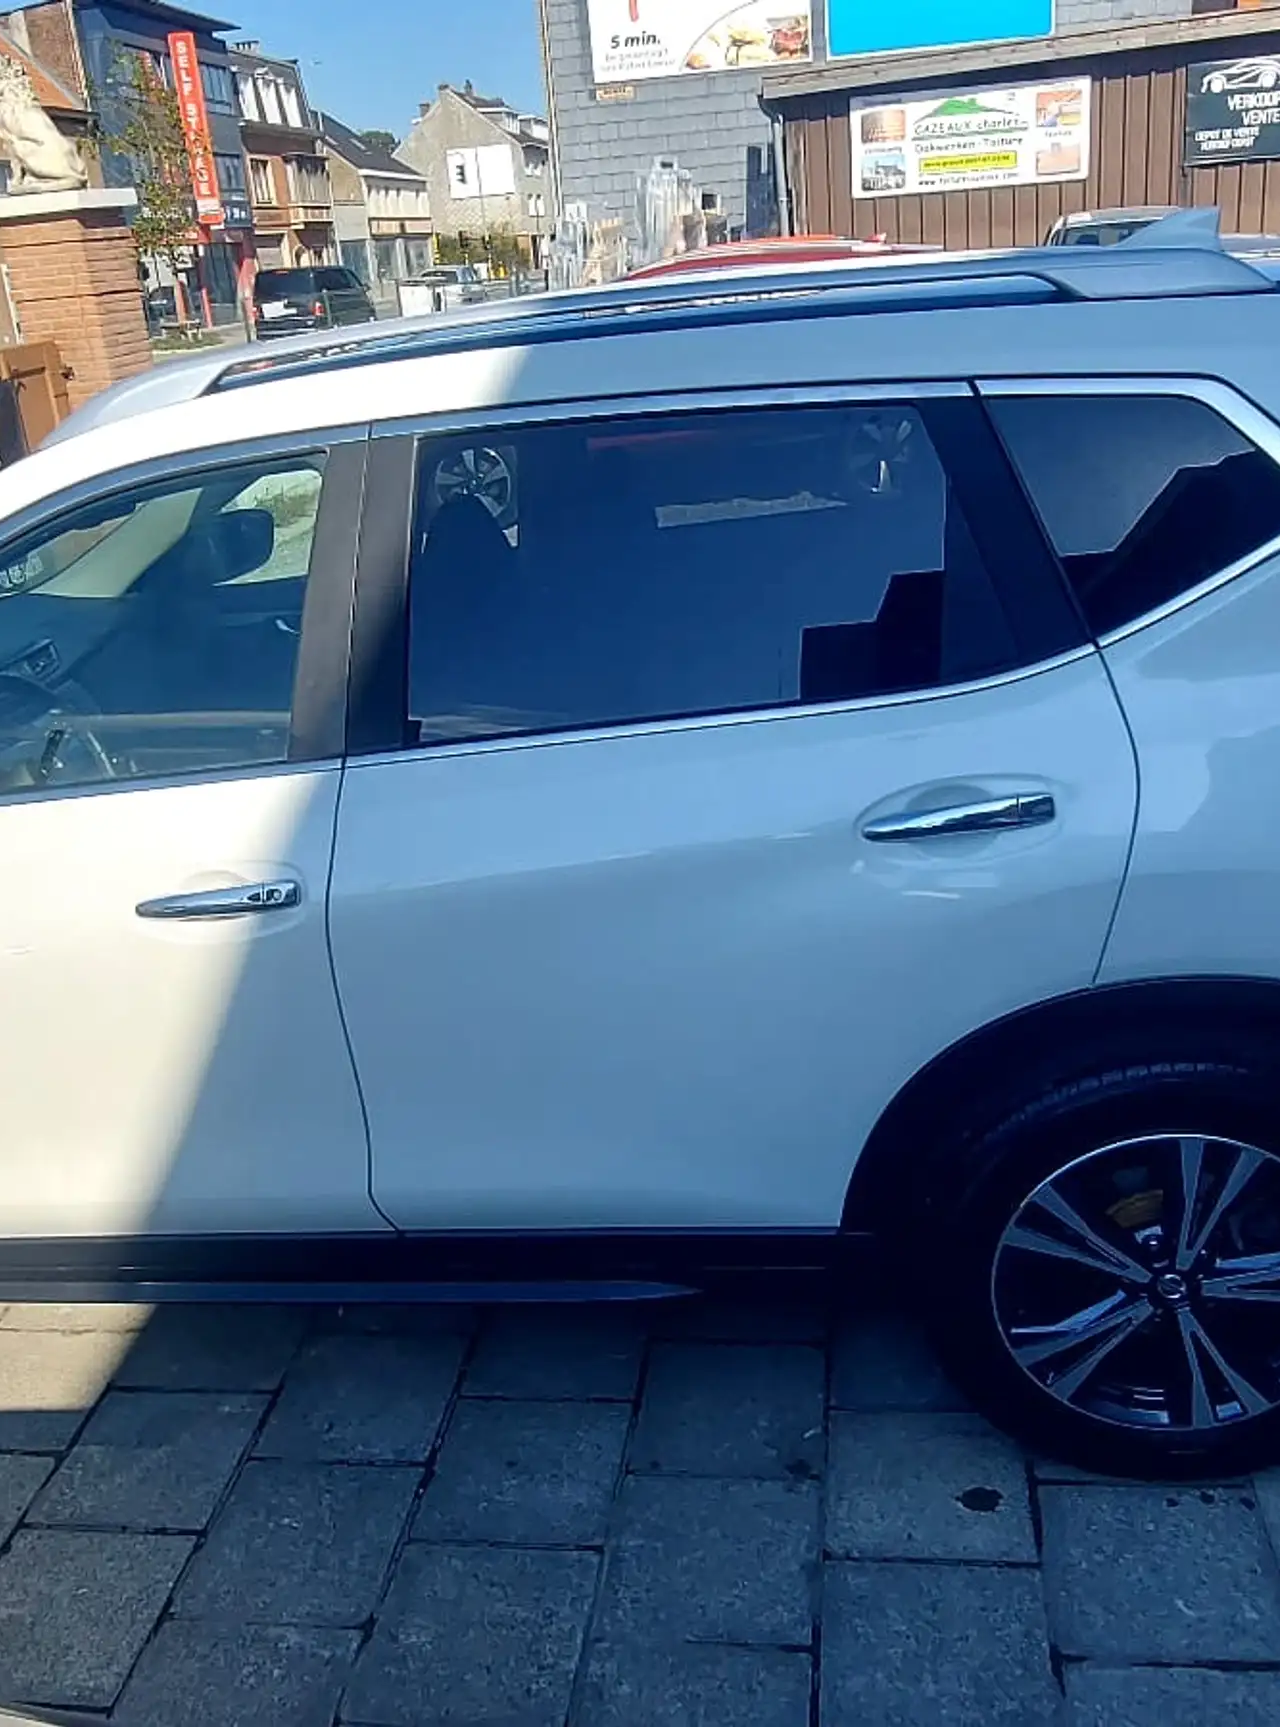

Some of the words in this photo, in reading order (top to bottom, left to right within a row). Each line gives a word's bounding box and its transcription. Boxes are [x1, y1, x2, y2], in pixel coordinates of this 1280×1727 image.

[611, 34, 621, 49] 5
[624, 31, 661, 47] min.
[176, 40, 192, 97] SELF
